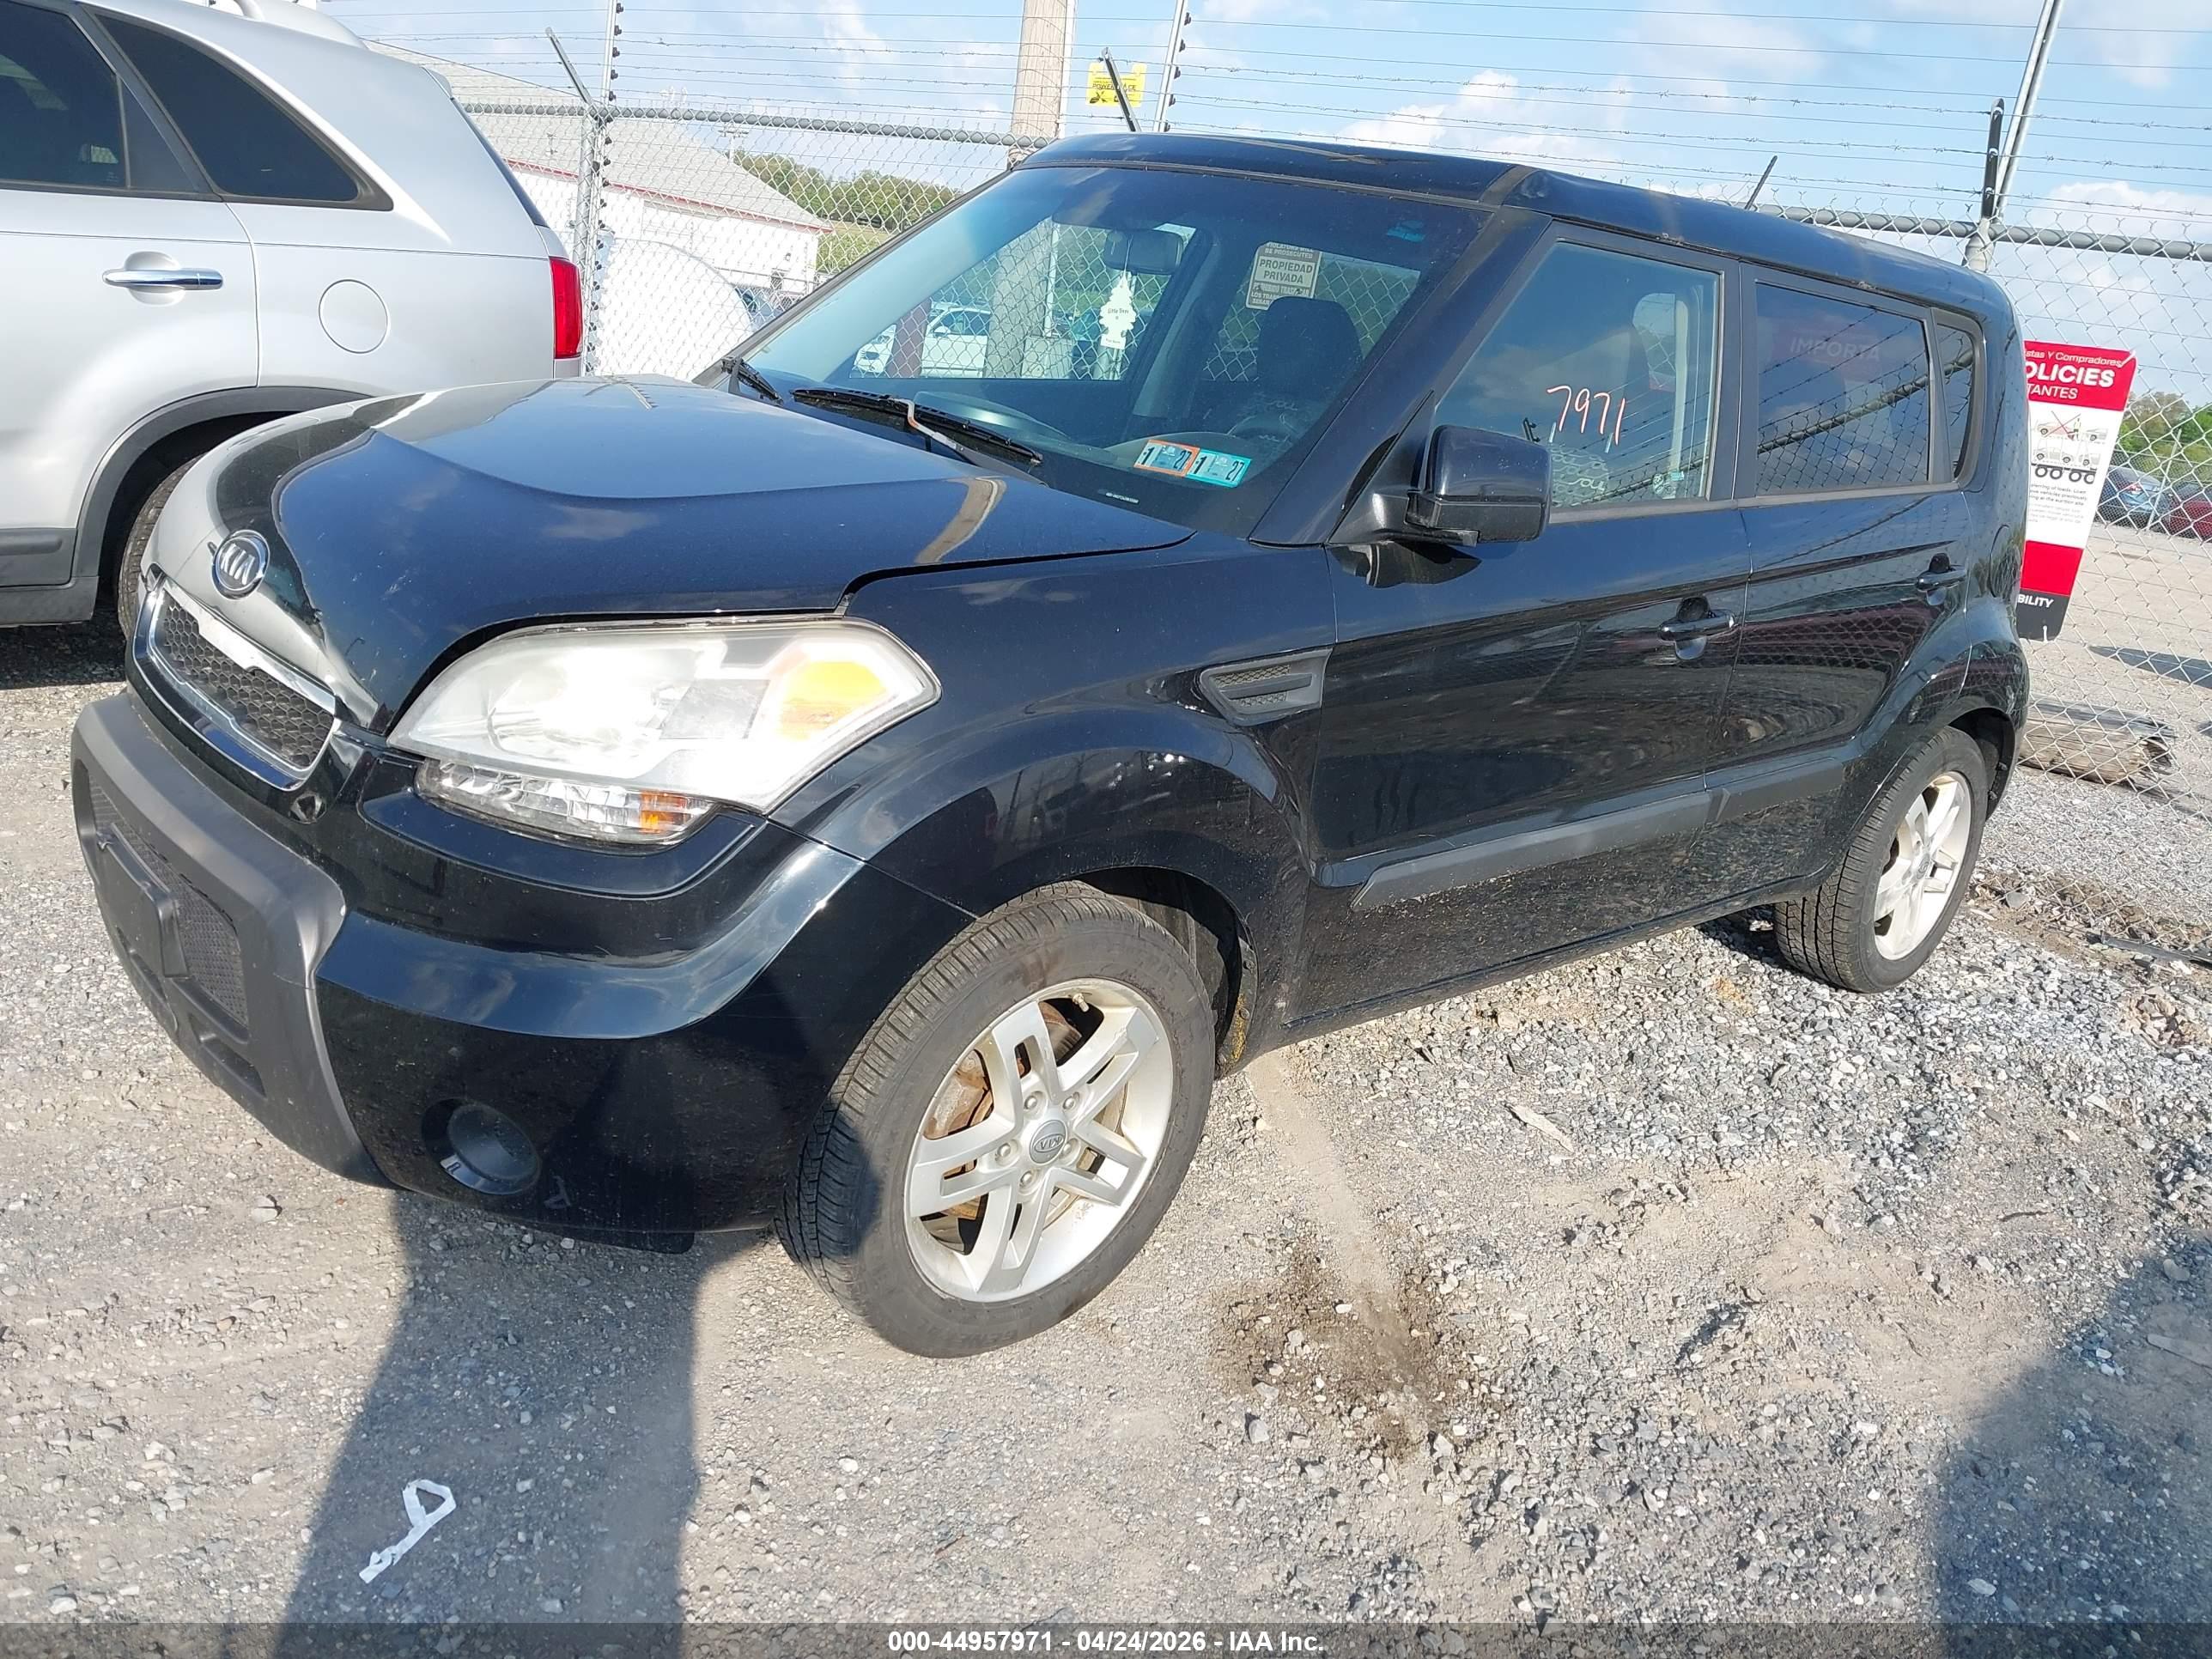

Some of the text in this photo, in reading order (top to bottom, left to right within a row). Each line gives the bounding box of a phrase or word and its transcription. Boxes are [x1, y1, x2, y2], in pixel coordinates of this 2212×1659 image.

[1259, 258, 1313, 274] PROPIEDAD
[1263, 270, 1304, 283] PRIVADA
[2056, 352, 2122, 368] Compradores
[2025, 361, 2115, 387] OLICIES
[1547, 385, 1626, 446] 7971
[1173, 449, 1193, 471] 27
[1225, 460, 1245, 482] 27
[2017, 593, 2055, 608] BILITY
